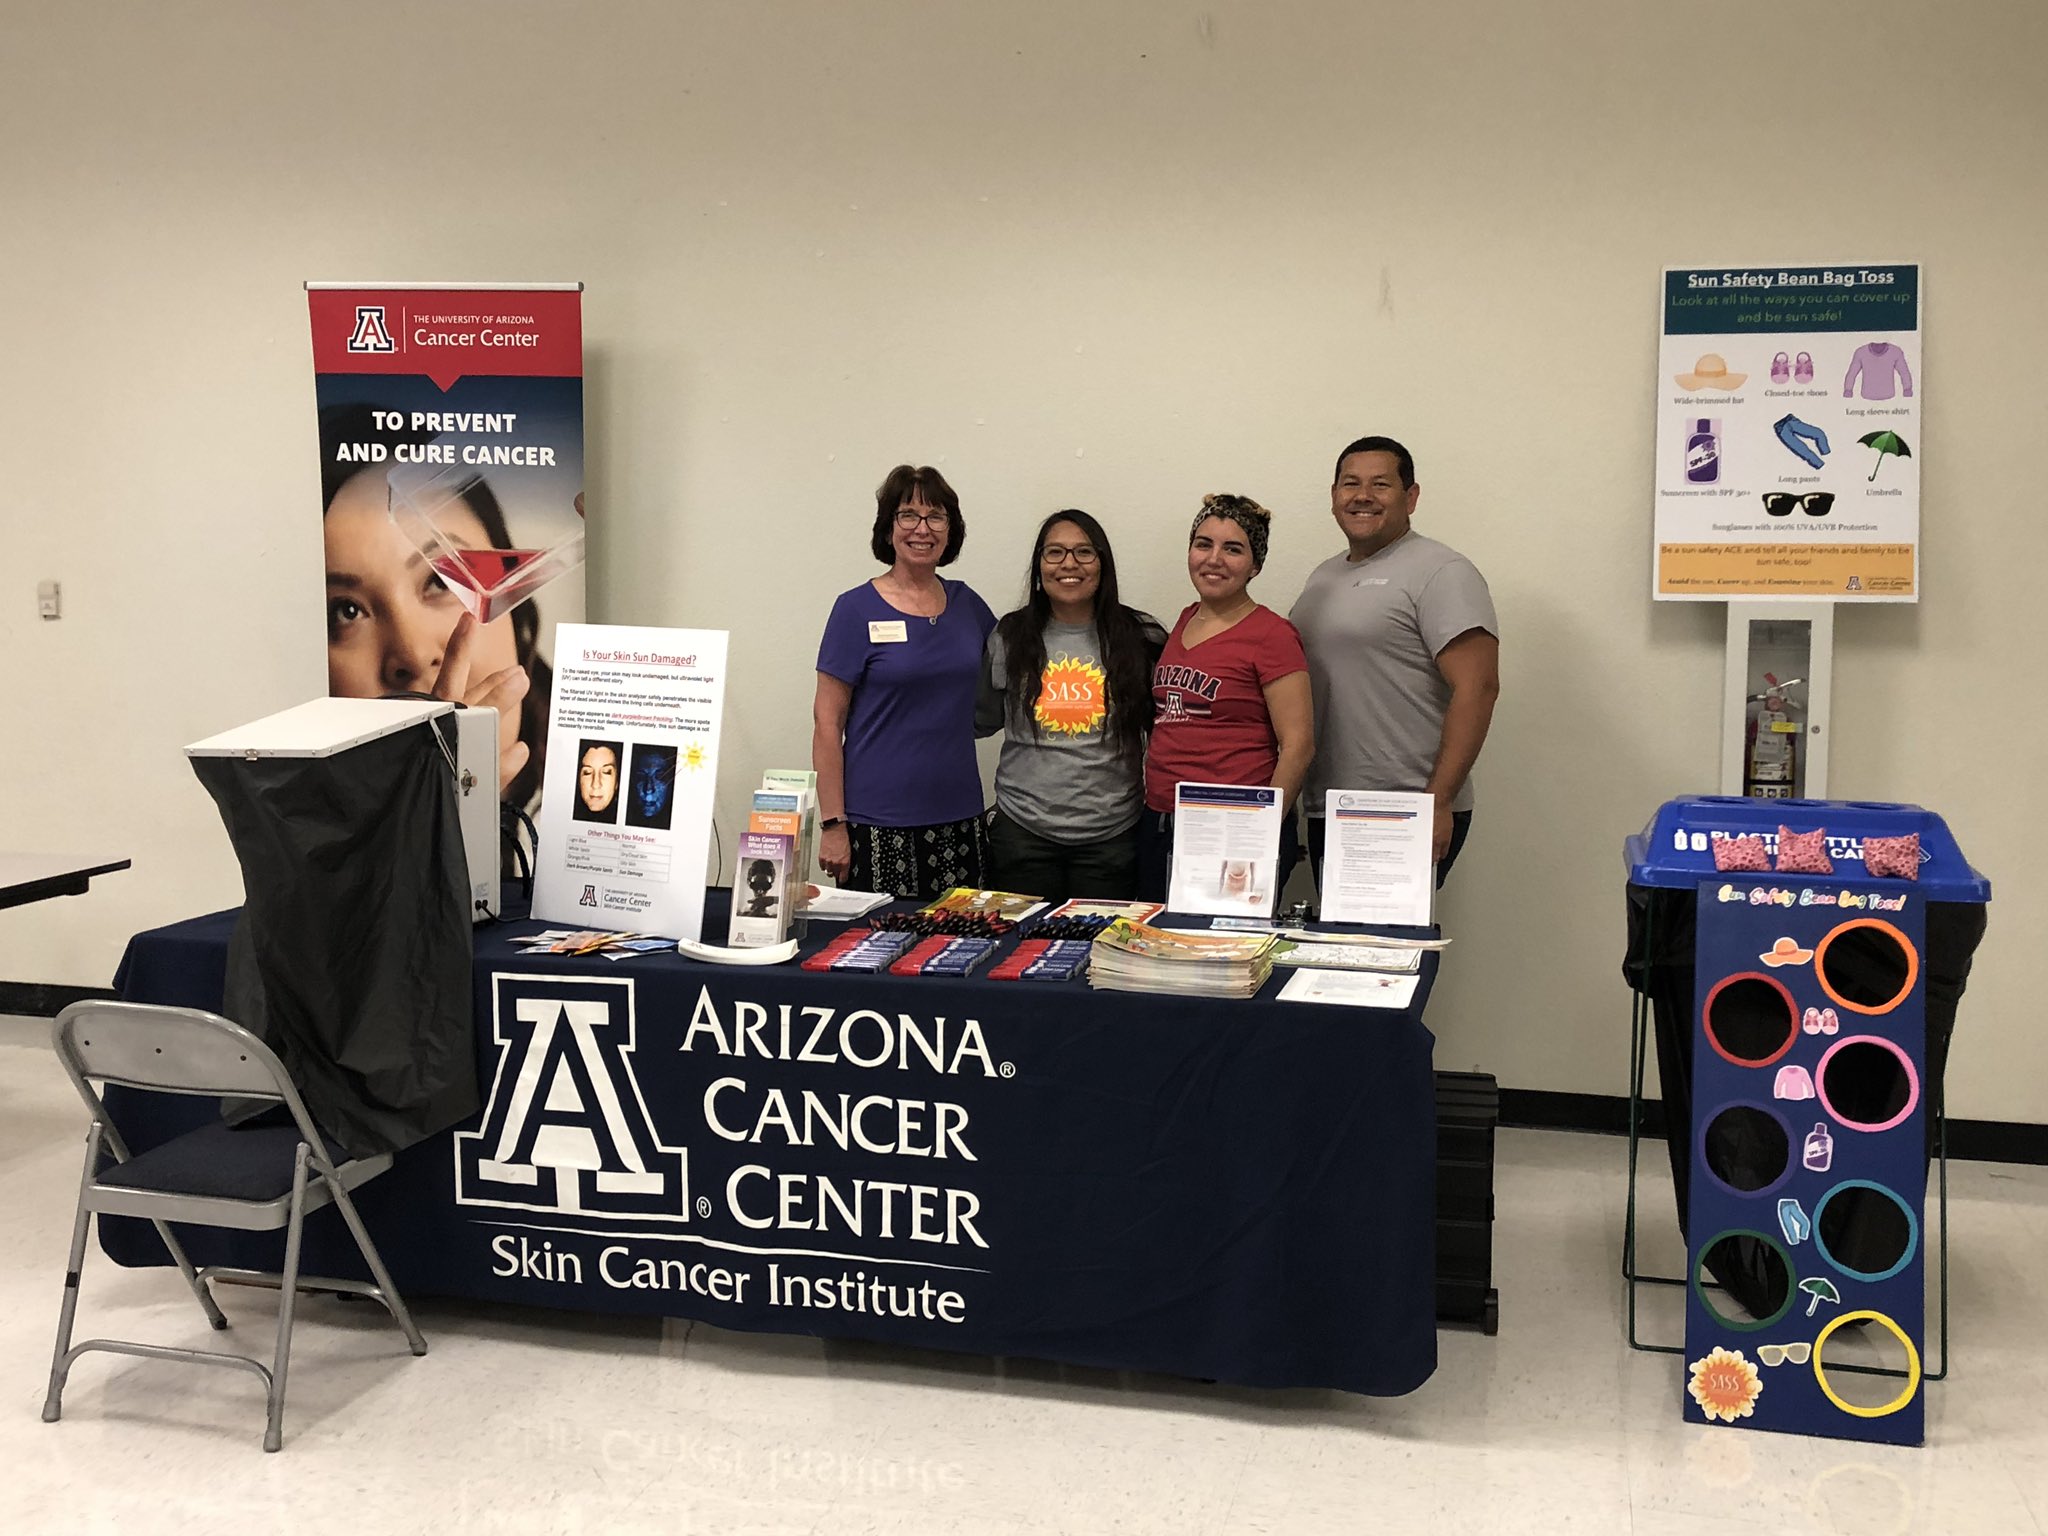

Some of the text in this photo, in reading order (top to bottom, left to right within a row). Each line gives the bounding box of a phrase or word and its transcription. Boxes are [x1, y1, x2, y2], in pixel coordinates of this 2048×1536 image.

[1688, 270, 1895, 289] Sun Safety Bean Bag Toss
[1672, 293, 1911, 306] Look at all the ways you can cover up
[413, 315, 535, 324] THE UNIVERSITY OF ARIZONA
[1737, 310, 1842, 323] and be sun safe!
[347, 306, 395, 353] A
[414, 328, 540, 347] Cancer Center
[1806, 389, 1828, 397] shoes
[1845, 408, 1866, 417] Long
[371, 411, 517, 433] TO PREVENT
[336, 442, 557, 466] AND CURE CANCER
[1778, 475, 1821, 484] Long pants
[1866, 488, 1903, 496] Umbrella
[1755, 523, 1771, 531] with
[1661, 546, 1673, 554] Be
[1698, 546, 1722, 555] safety
[1724, 546, 1742, 554] ACE
[1744, 546, 1761, 554] and
[1762, 546, 1776, 554] tell
[1777, 546, 1788, 554] all
[1789, 547, 1808, 555] your
[1810, 546, 1839, 554] friends
[1841, 546, 1858, 554] and
[1860, 546, 1886, 556] family
[583, 649, 697, 666] Is Your Skin Sun Damaged?
[1046, 681, 1093, 701] SASS
[1152, 664, 1222, 701] RIZONA
[758, 815, 792, 824] Sunscreen
[587, 829, 603, 838] Other
[604, 831, 621, 840] Things
[632, 834, 644, 843] May
[604, 893, 628, 904] Cancer
[628, 896, 652, 907] Center
[1799, 888, 1837, 906] Bean
[453, 972, 690, 1222] A
[703, 1076, 978, 1162] CANCER
[725, 1164, 991, 1249] CENTER
[491, 1235, 967, 1325] Skin Cancer Institute
[1710, 1373, 1741, 1392] SASS
